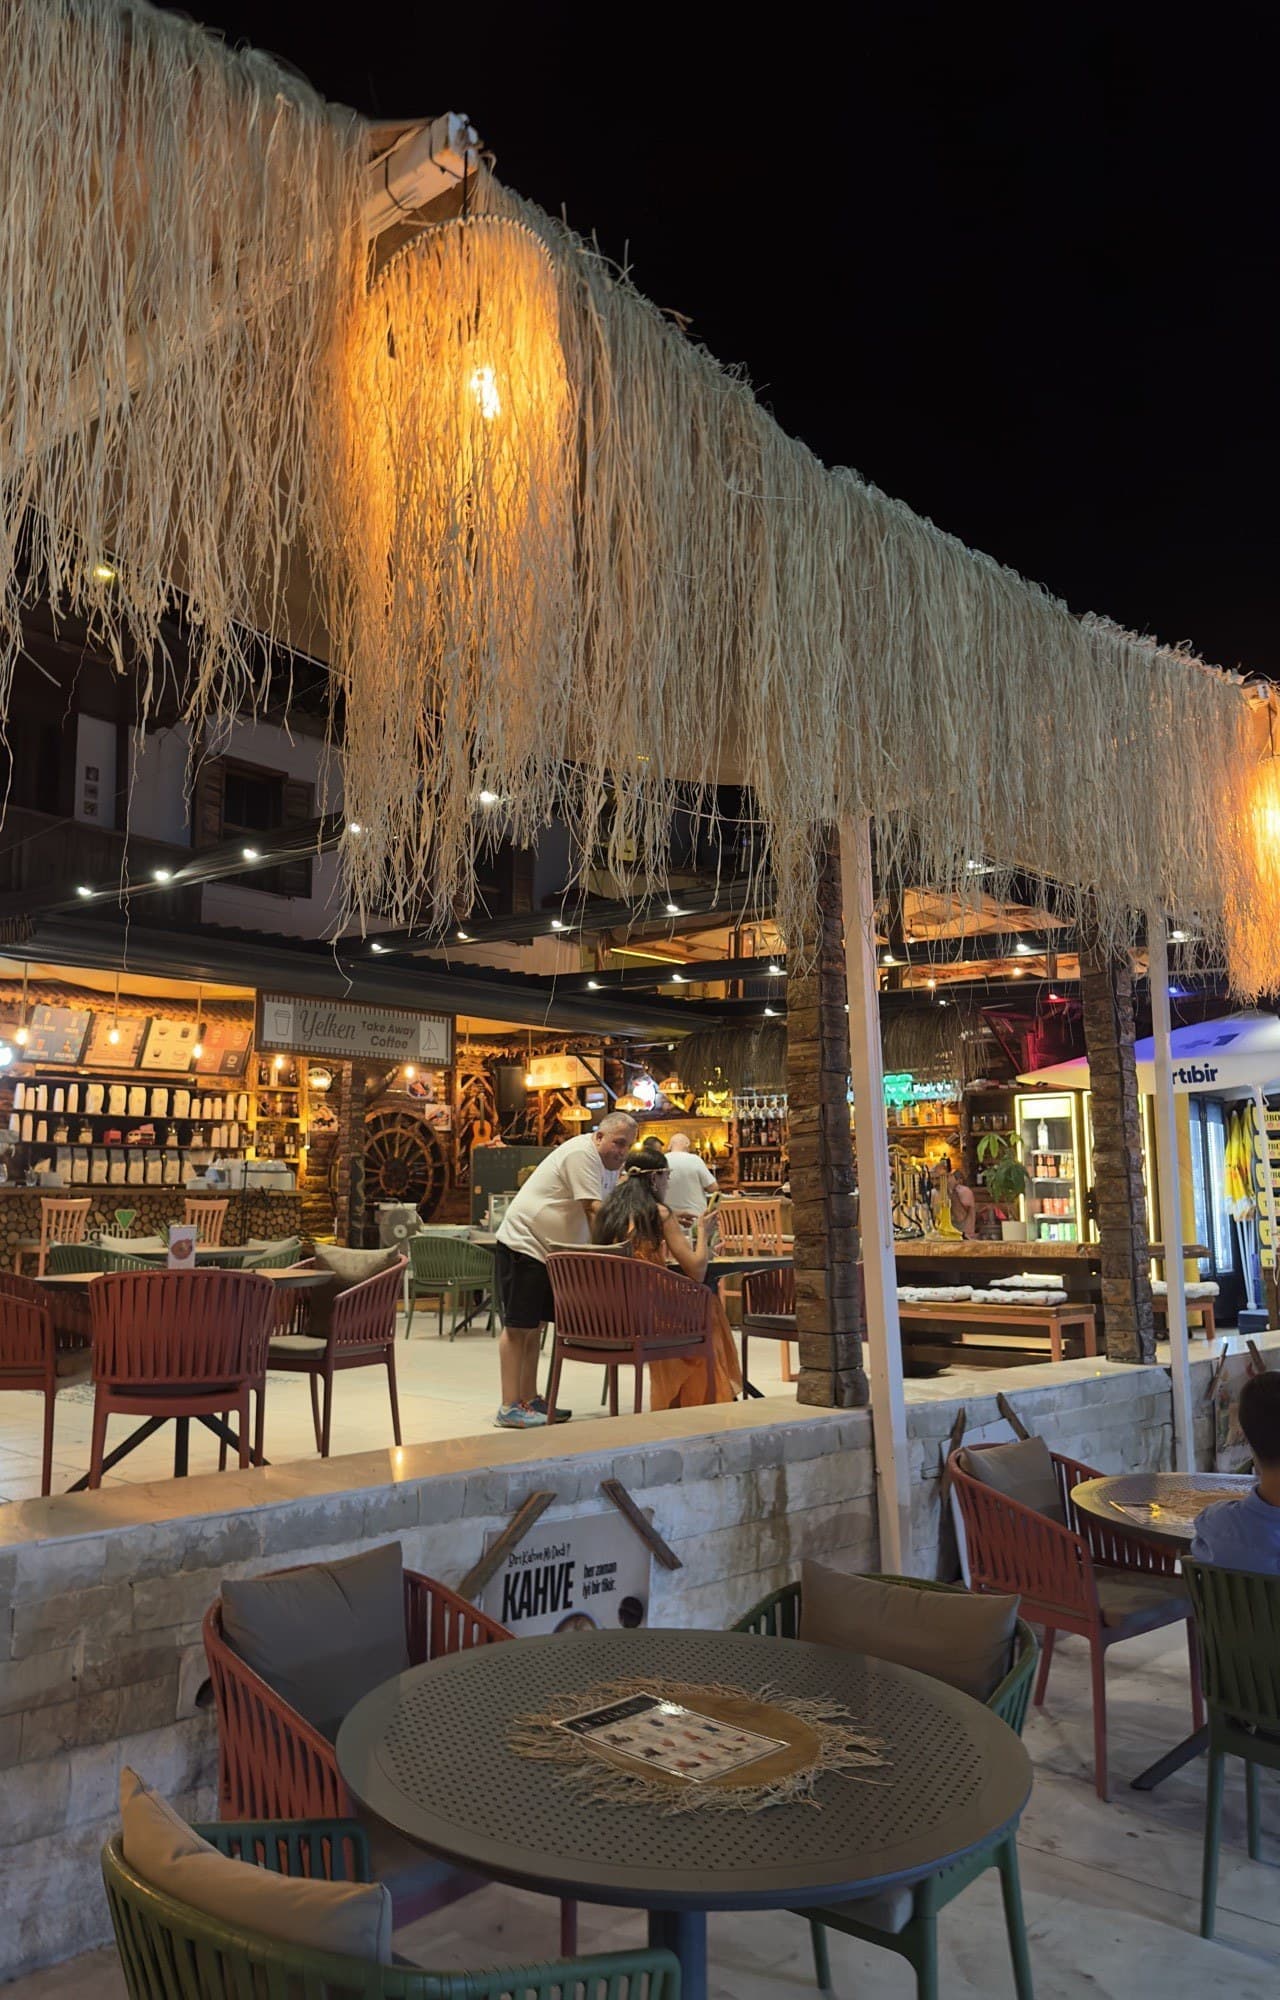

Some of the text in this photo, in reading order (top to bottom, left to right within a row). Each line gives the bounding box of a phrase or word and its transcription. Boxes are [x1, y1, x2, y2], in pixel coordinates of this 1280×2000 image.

[300, 1009, 356, 1043] Yelken
[361, 1020, 416, 1040] Take Away
[370, 1034, 408, 1049] Coffee
[1172, 1063, 1218, 1085] rtıbir
[502, 1560, 575, 1622] KAHVE
